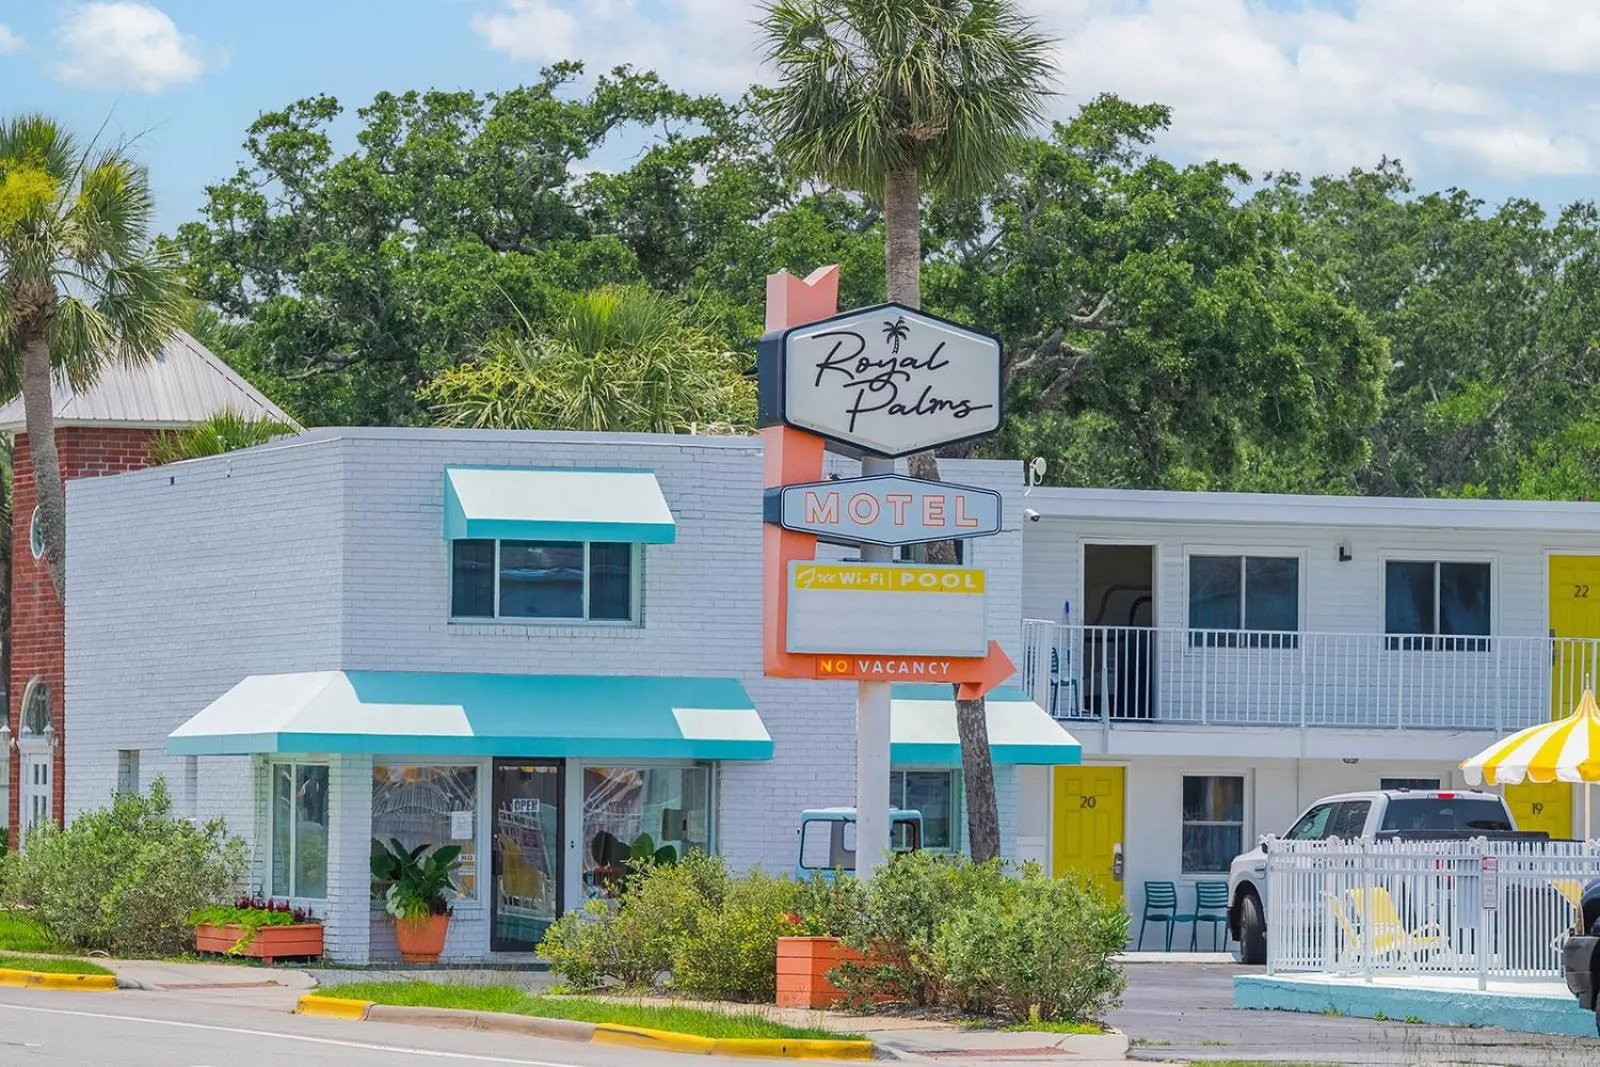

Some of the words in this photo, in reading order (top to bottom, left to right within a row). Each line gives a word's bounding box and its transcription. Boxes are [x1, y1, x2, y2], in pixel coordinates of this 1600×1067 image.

[811, 331, 949, 392] Royal
[843, 378, 993, 433] Palms
[804, 491, 979, 528] MOTEL
[797, 567, 837, 589] Free
[839, 572, 884, 586] Wi-Fi
[900, 572, 977, 589] POOL
[1574, 584, 1589, 598] 22
[820, 659, 848, 673] NO
[858, 660, 950, 675] VACANCY
[514, 799, 538, 811] OPEN
[1080, 795, 1097, 809] 20
[1532, 802, 1543, 815] 19
